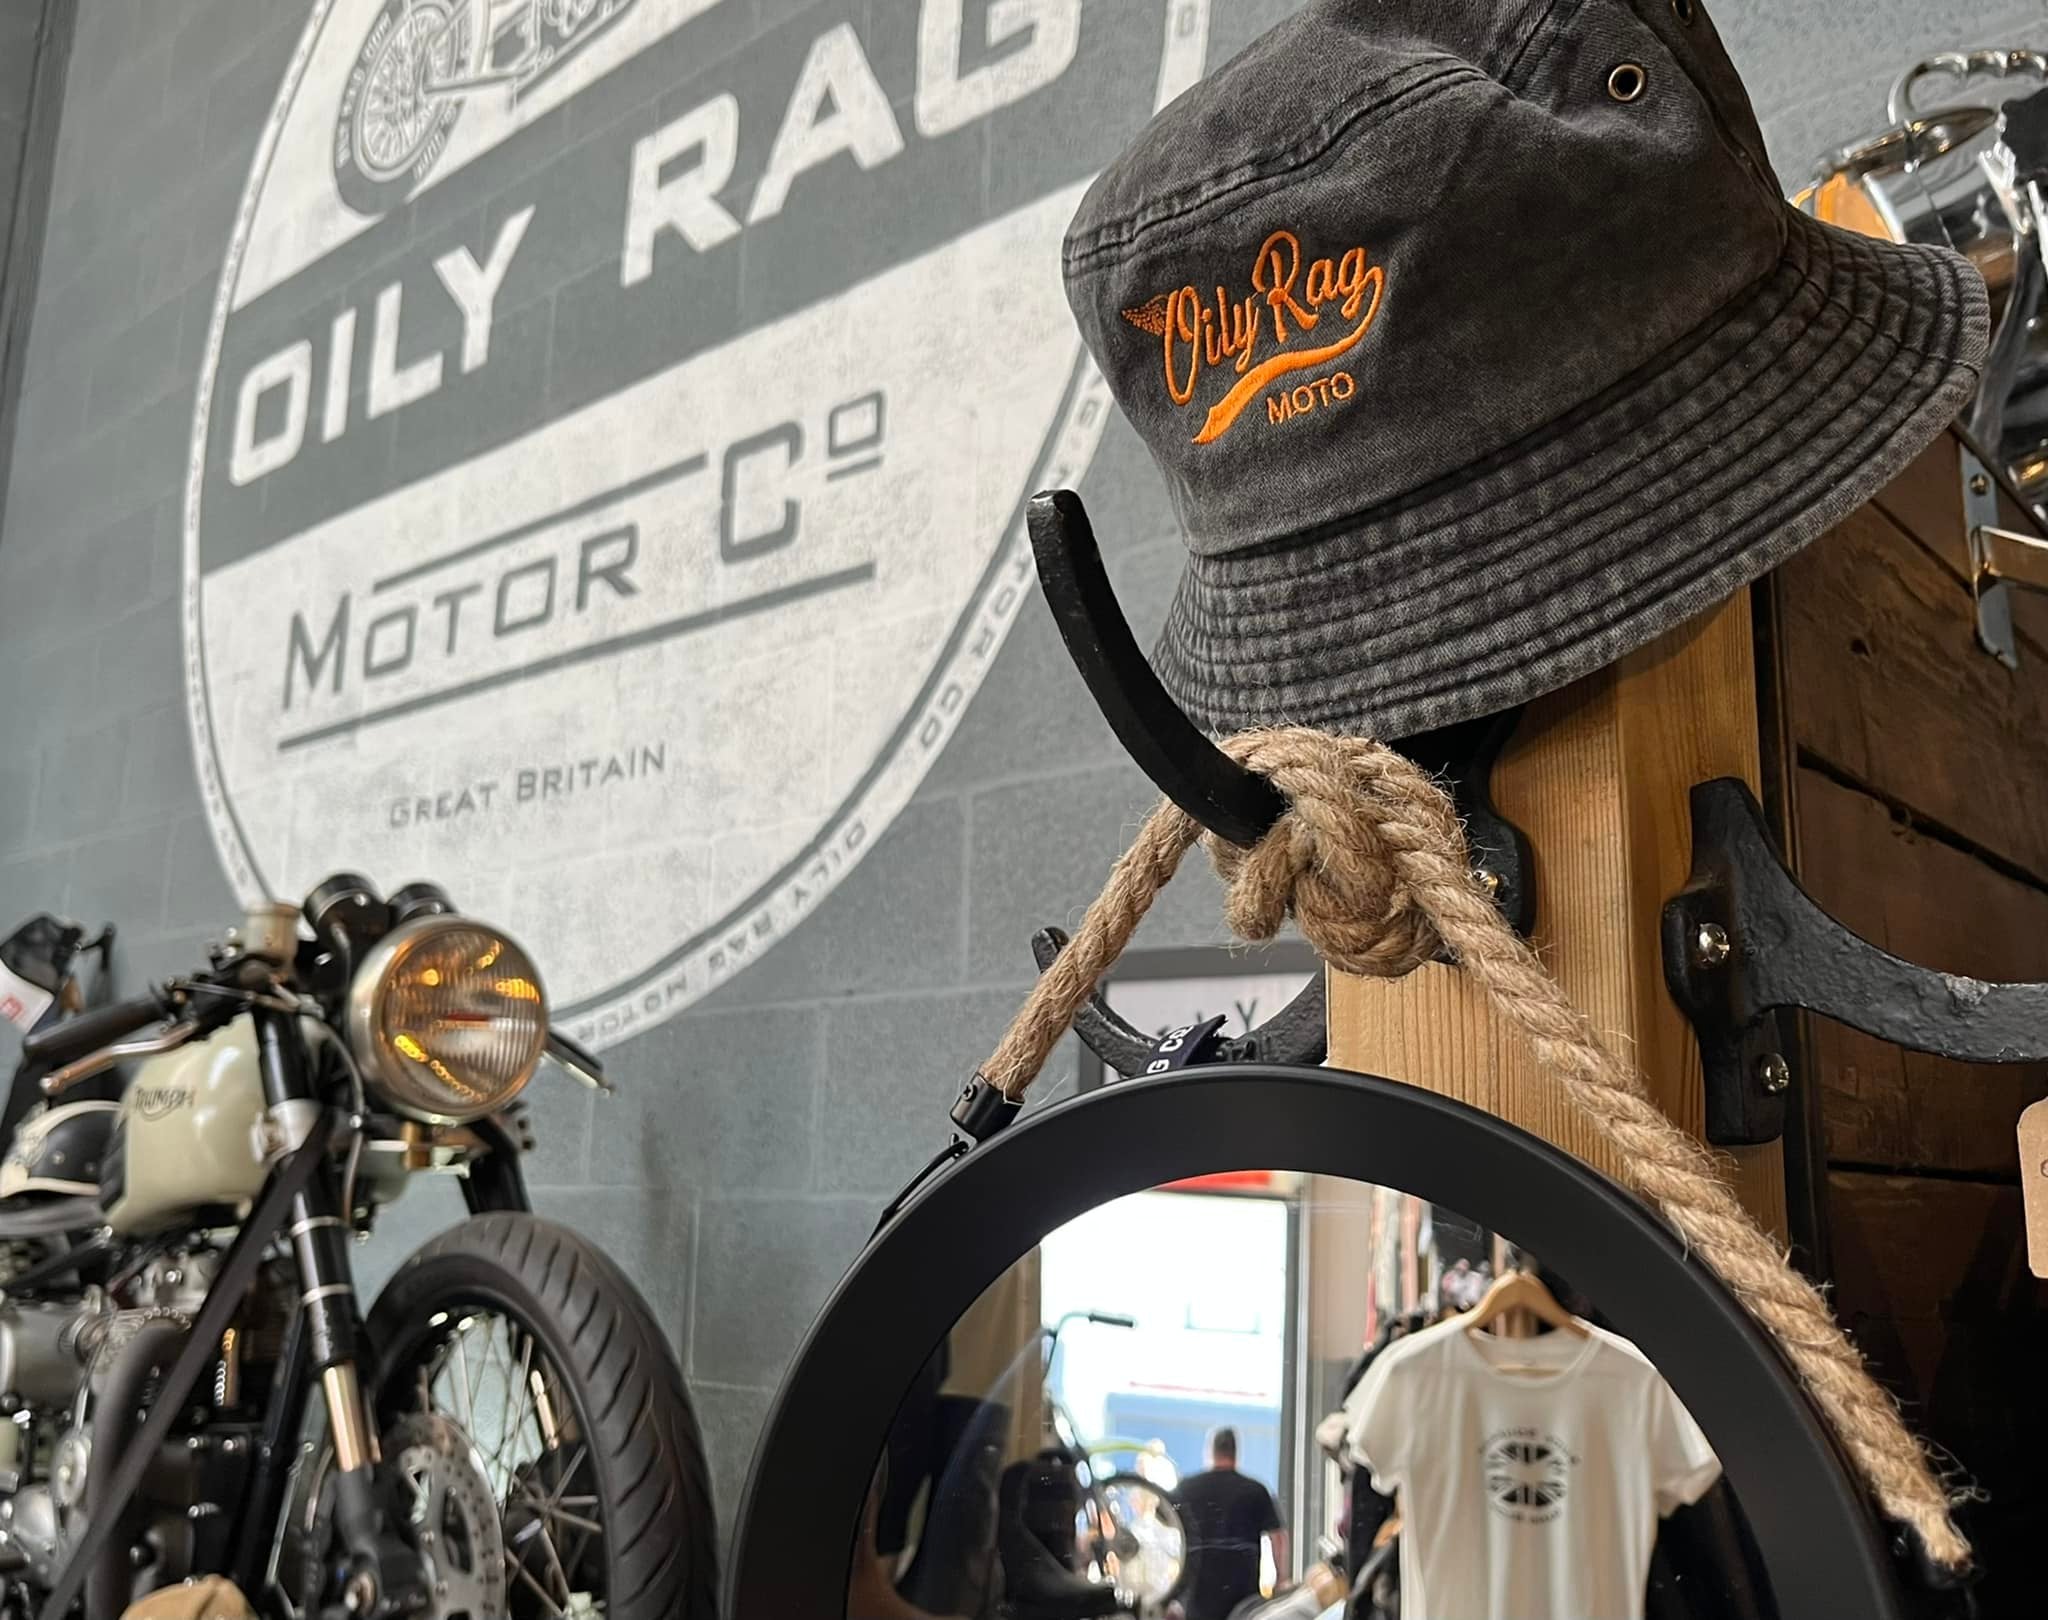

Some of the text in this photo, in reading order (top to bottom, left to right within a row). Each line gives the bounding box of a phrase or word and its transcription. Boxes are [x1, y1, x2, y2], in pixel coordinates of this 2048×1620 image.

[229, 204, 536, 487] OILY
[620, 0, 1081, 288] RAG
[1164, 285, 1259, 405] Oily
[1252, 230, 1384, 344] Rag
[1266, 371, 1356, 425] MOTO
[282, 522, 640, 710] MOTOR
[389, 743, 666, 829] GREAT BRITAIN
[792, 819, 867, 909] OILY
